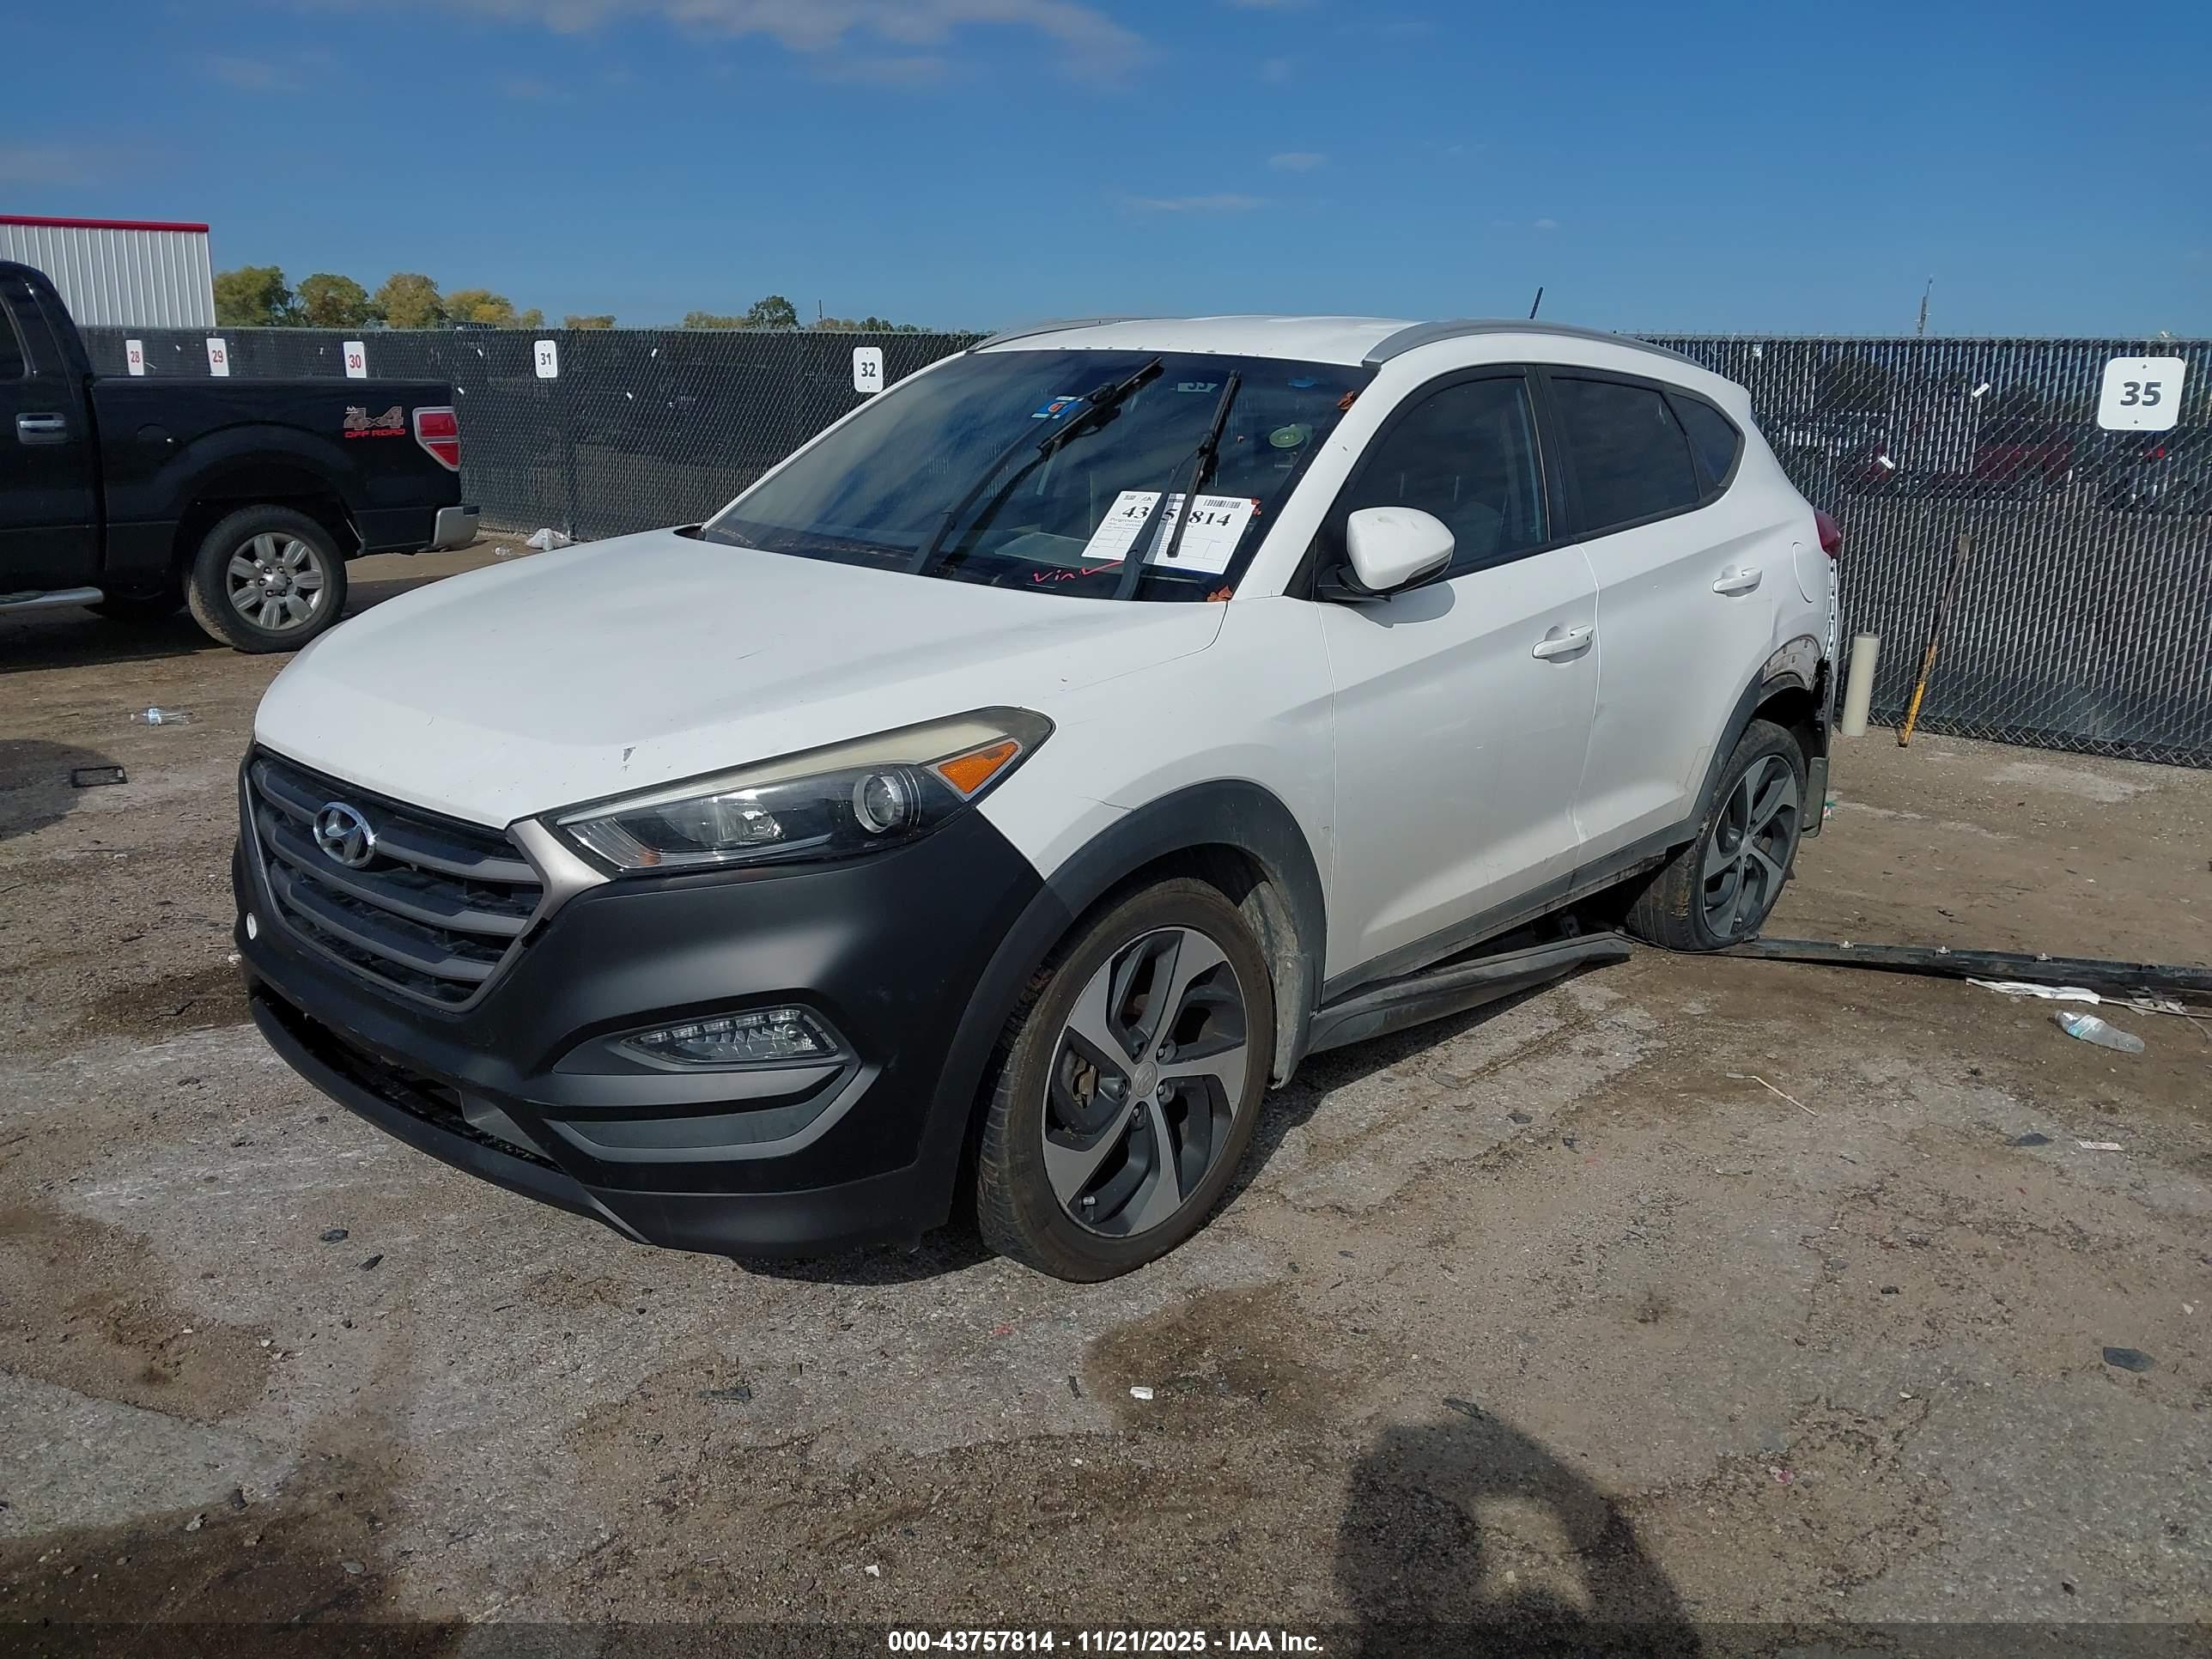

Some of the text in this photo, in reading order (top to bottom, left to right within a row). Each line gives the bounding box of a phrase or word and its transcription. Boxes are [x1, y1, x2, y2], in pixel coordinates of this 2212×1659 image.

[130, 350, 140, 363] 28
[212, 349, 224, 363] 29
[349, 354, 362, 369] 30
[540, 352, 551, 366] 31
[860, 362, 876, 378] 32
[2119, 380, 2162, 407] 35
[344, 428, 406, 439] OFF ROAD
[1121, 506, 1231, 526] 435814
